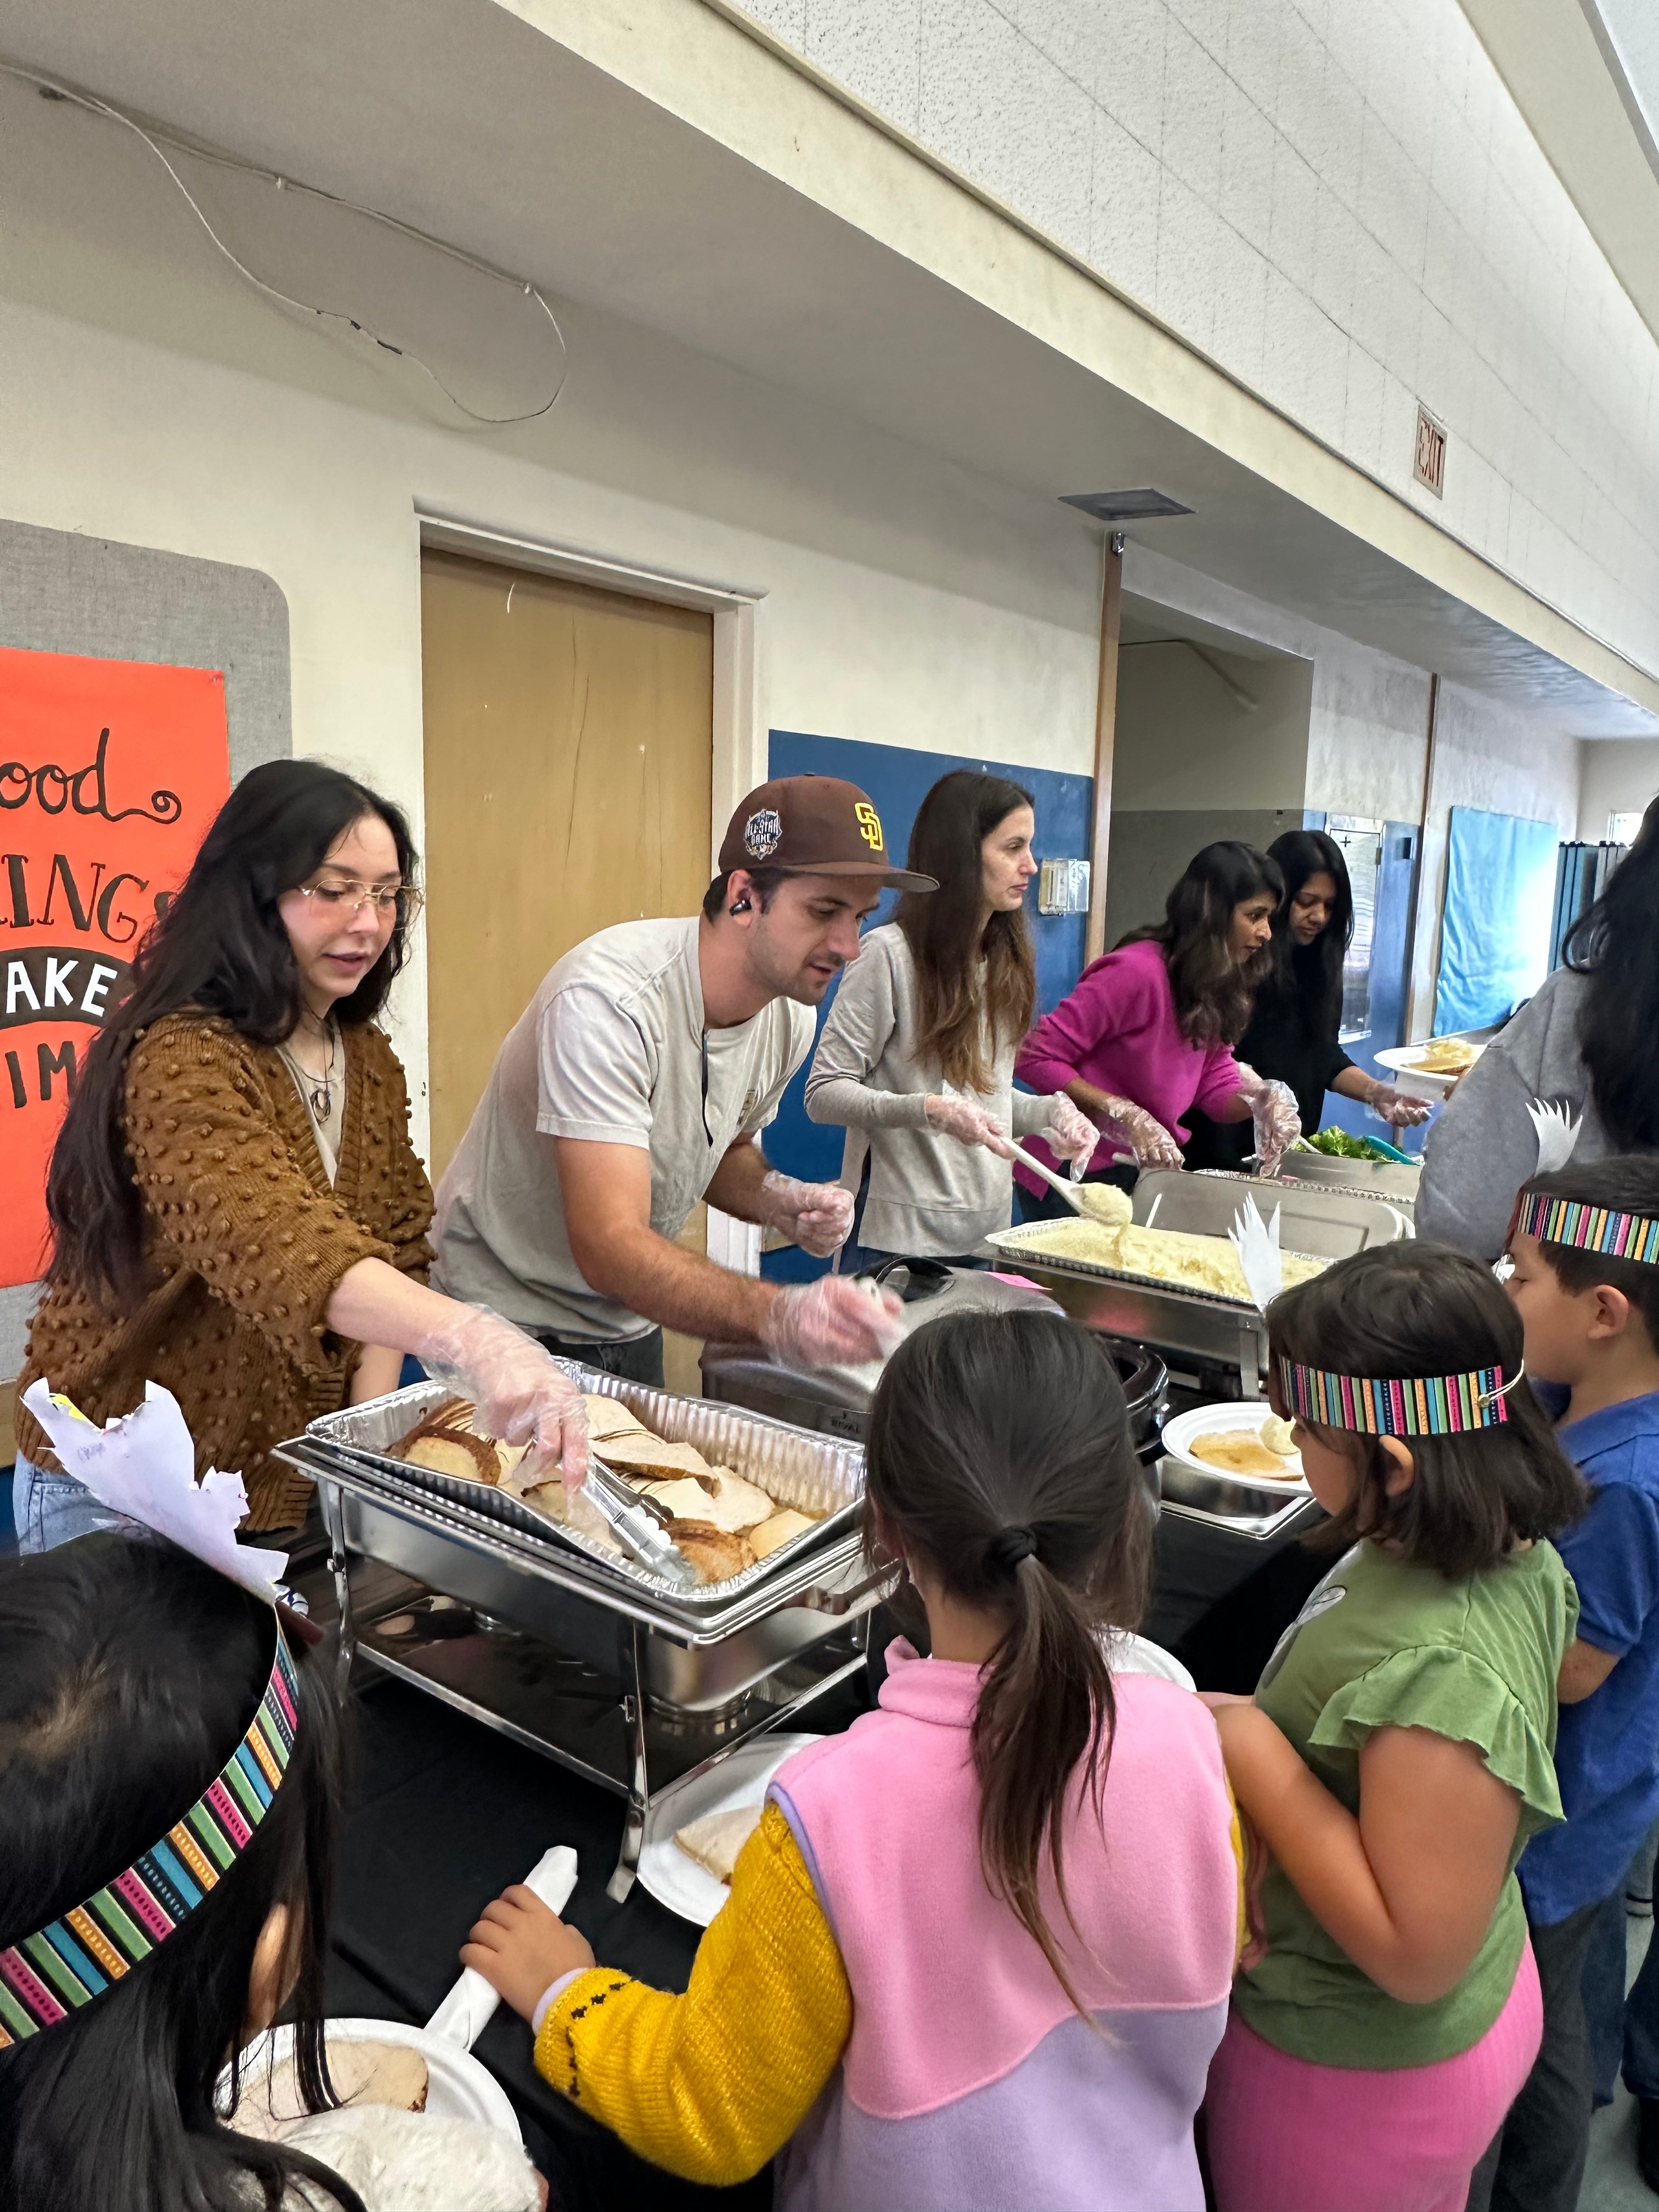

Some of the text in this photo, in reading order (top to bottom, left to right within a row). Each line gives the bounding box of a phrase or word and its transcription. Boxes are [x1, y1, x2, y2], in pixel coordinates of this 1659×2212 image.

[1418, 416, 1444, 487] EXIT
[854, 802, 884, 851] SD
[0, 854, 181, 943] ING
[6, 957, 118, 1017] AKE
